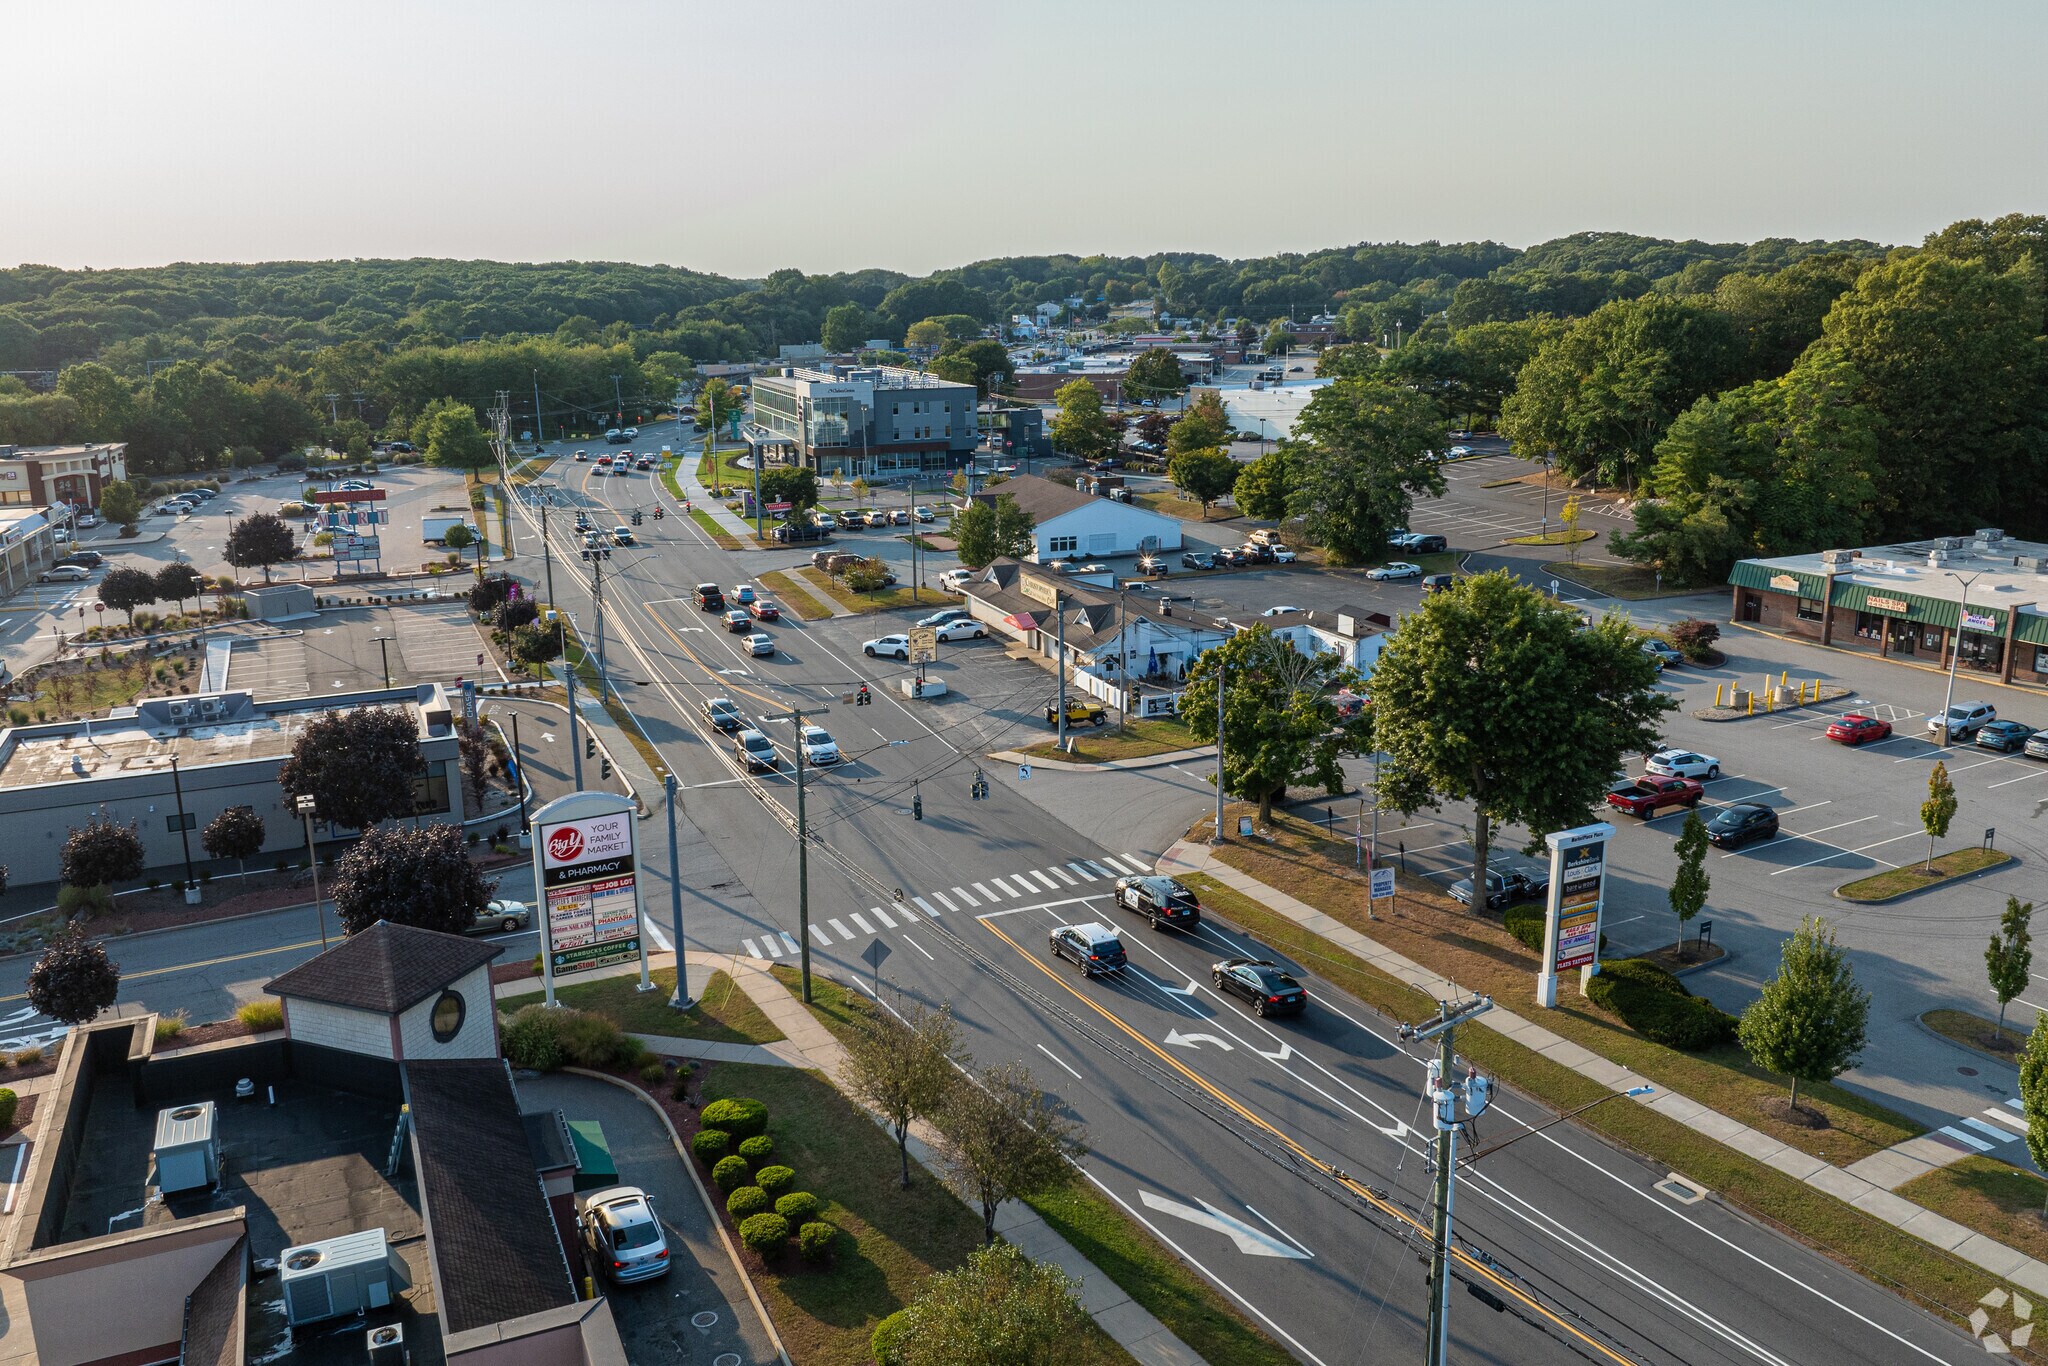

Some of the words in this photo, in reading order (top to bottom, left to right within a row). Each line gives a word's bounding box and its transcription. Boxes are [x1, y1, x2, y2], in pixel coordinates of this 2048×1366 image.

[7, 472, 15, 480] 24
[318, 509, 388, 527] MART
[1868, 596, 1890, 605] NAILS
[1891, 600, 1906, 608] SPA
[1967, 617, 1987, 626] ANGEL
[465, 691, 474, 718] CHASE
[591, 822, 618, 833] YOUR
[590, 832, 621, 844] FAMILY
[587, 841, 625, 855] MARKET
[559, 871, 566, 879] &
[567, 861, 620, 878] PHARMACY
[1567, 869, 1581, 877] Louis
[1584, 865, 1598, 873] Clark
[605, 880, 619, 889] JOB
[620, 877, 633, 885] LOT
[598, 914, 633, 925] PHANTASIA
[565, 946, 602, 959] STARBUCKS
[603, 942, 626, 952] COFFEE
[1572, 955, 1593, 965] TATTOOS
[555, 960, 596, 974] GameStop
